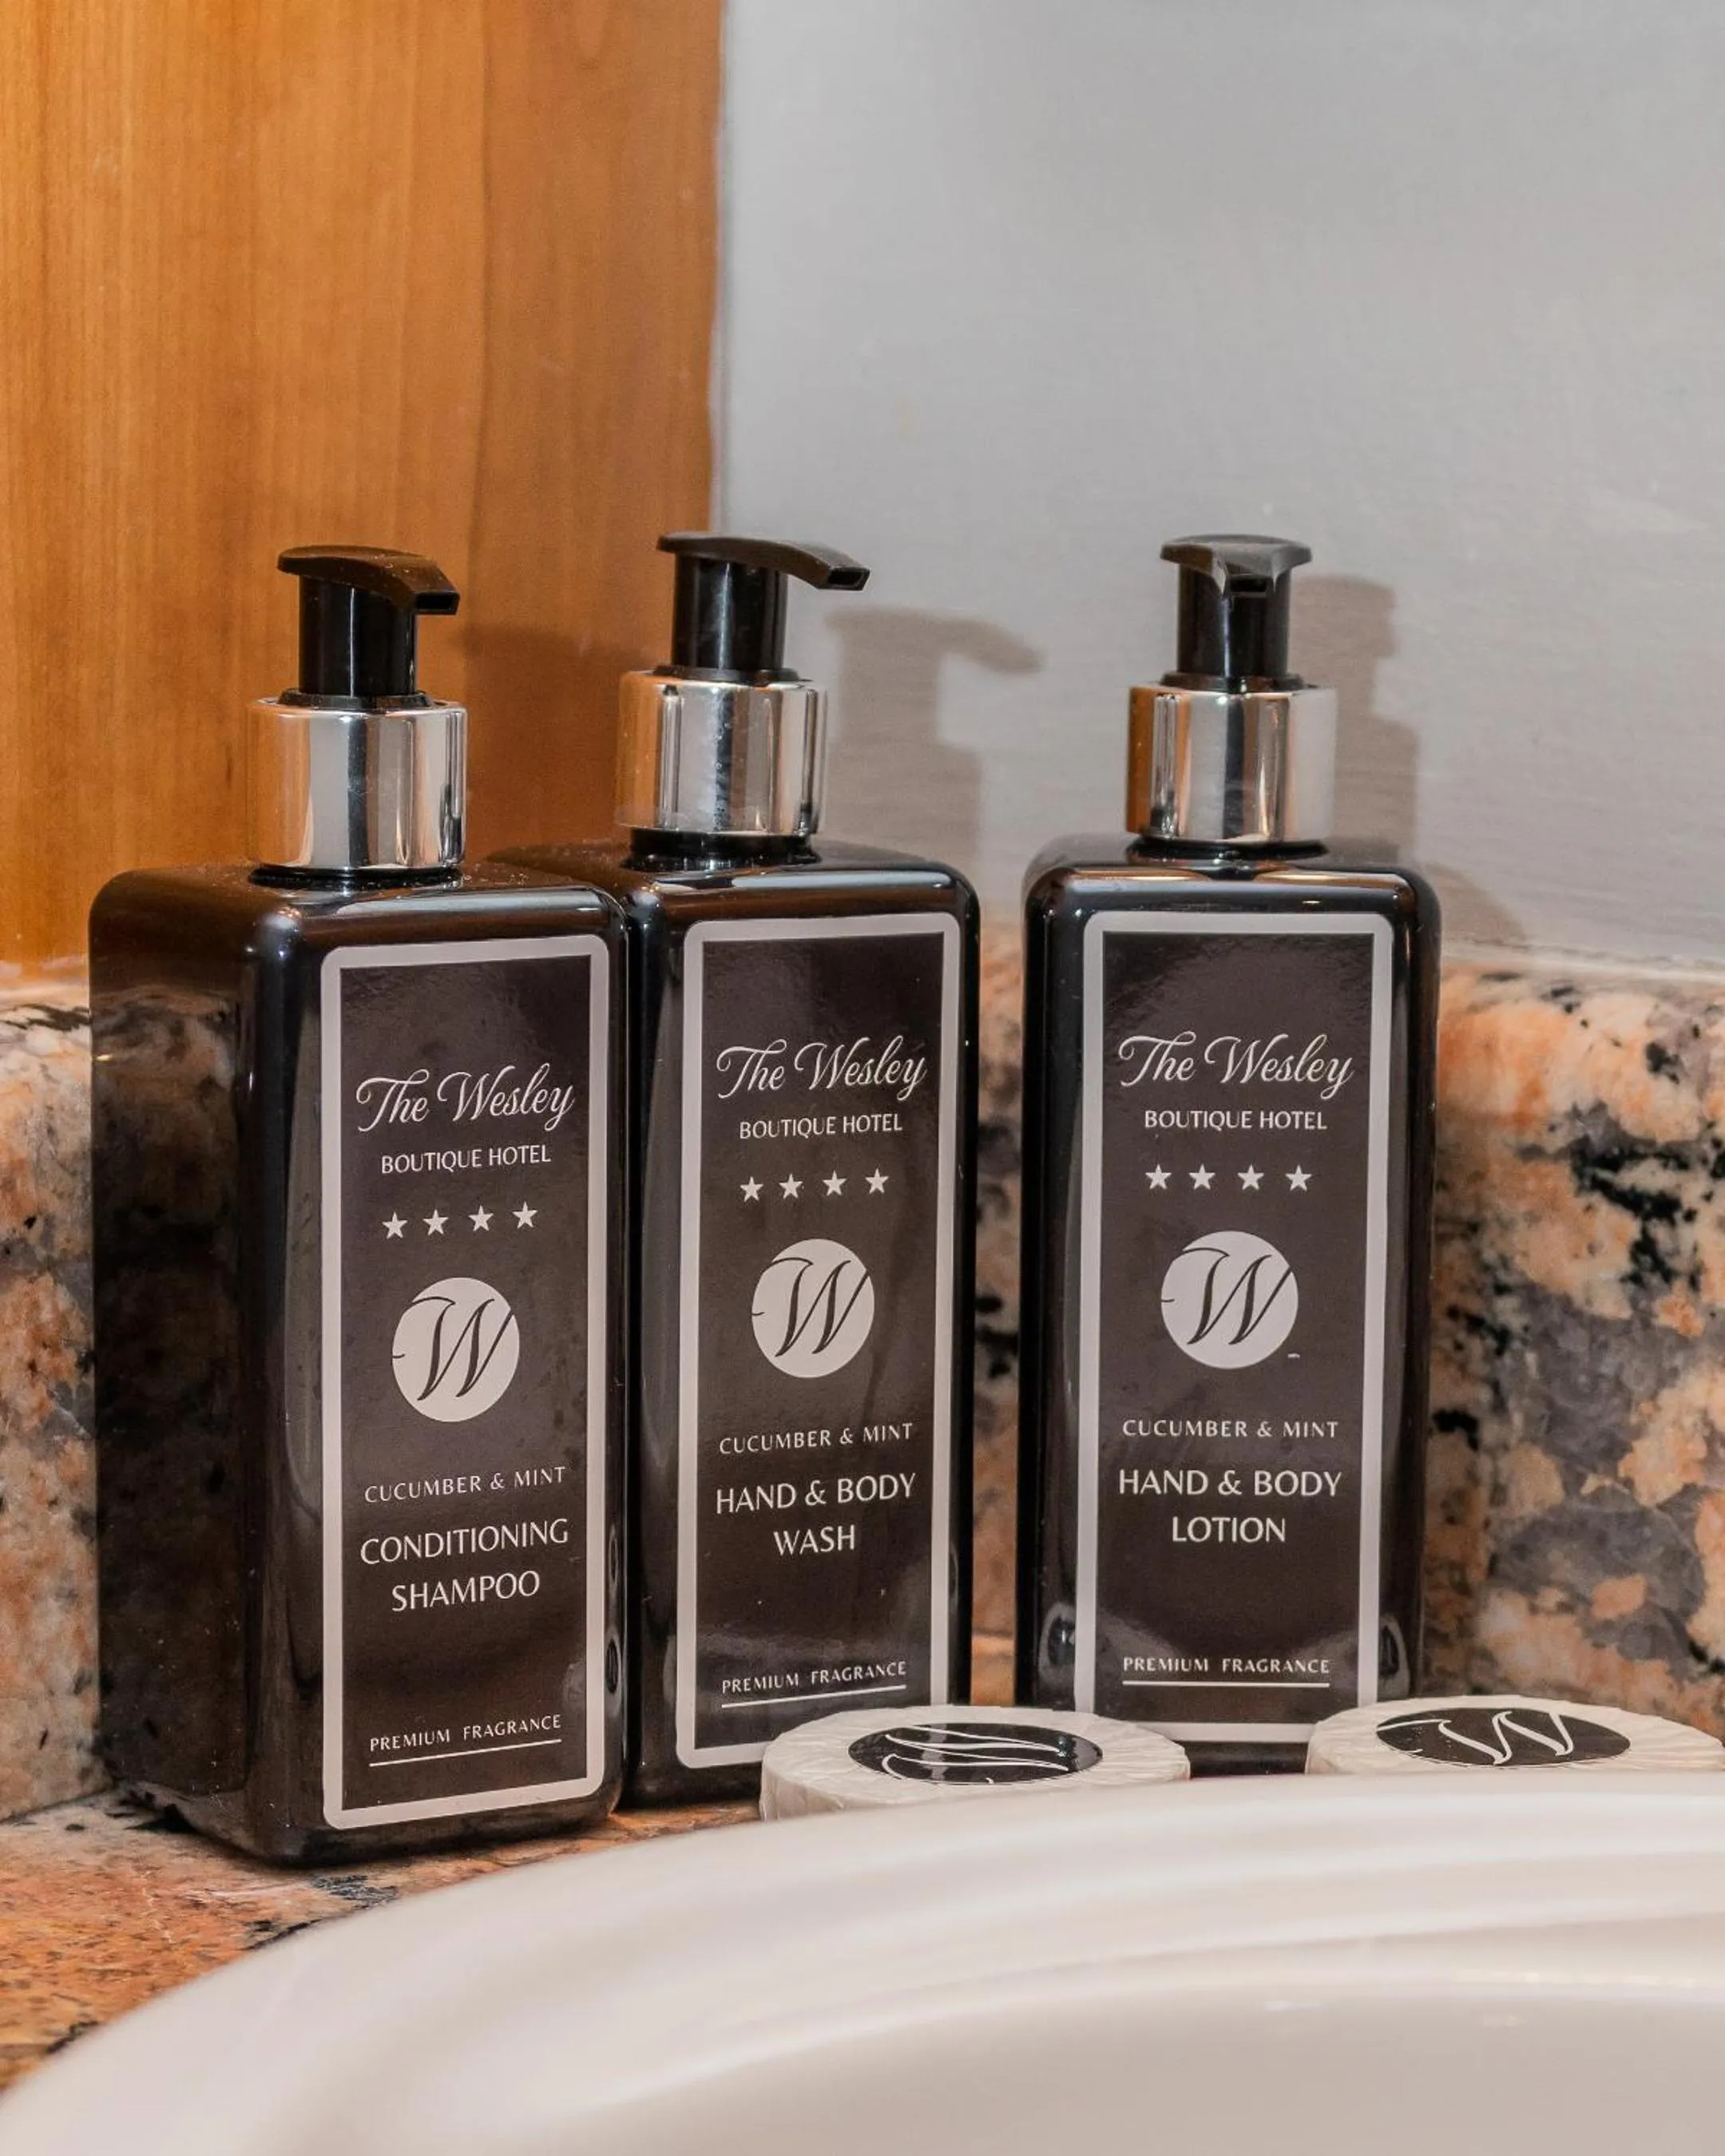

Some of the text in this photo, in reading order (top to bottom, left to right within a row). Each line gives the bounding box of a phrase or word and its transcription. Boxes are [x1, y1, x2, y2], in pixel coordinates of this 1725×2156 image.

[716, 1034, 926, 1103] The Wesley
[1118, 1030, 1353, 1102] The Wesley
[355, 1063, 573, 1133] The Wesley
[740, 1113, 902, 1139] BOUTIQUE HOTEL
[1144, 1110, 1327, 1132] BOUTIQUE HOTEL
[381, 1144, 551, 1174] BOUTIQUE HOTEL
[719, 1422, 913, 1454] CUCUMBER & MINT
[1122, 1419, 1339, 1438] CUCUMBER & MINT
[364, 1466, 566, 1503] CUCUMBER & MINT
[716, 1472, 916, 1515] HAND & BODY
[1120, 1469, 1342, 1496] HAND & BODY
[359, 1517, 569, 1566] CONDITIONING
[773, 1524, 855, 1556] WASH
[1172, 1516, 1286, 1543] LOTION
[391, 1569, 541, 1612] SHAMPOO
[721, 1660, 906, 1694] PREMIUM FRAGRANCE
[1122, 1655, 1330, 1674] PREMIUM FRAGRANCE
[370, 1714, 561, 1752] PREMIUM FRAGRANCE
